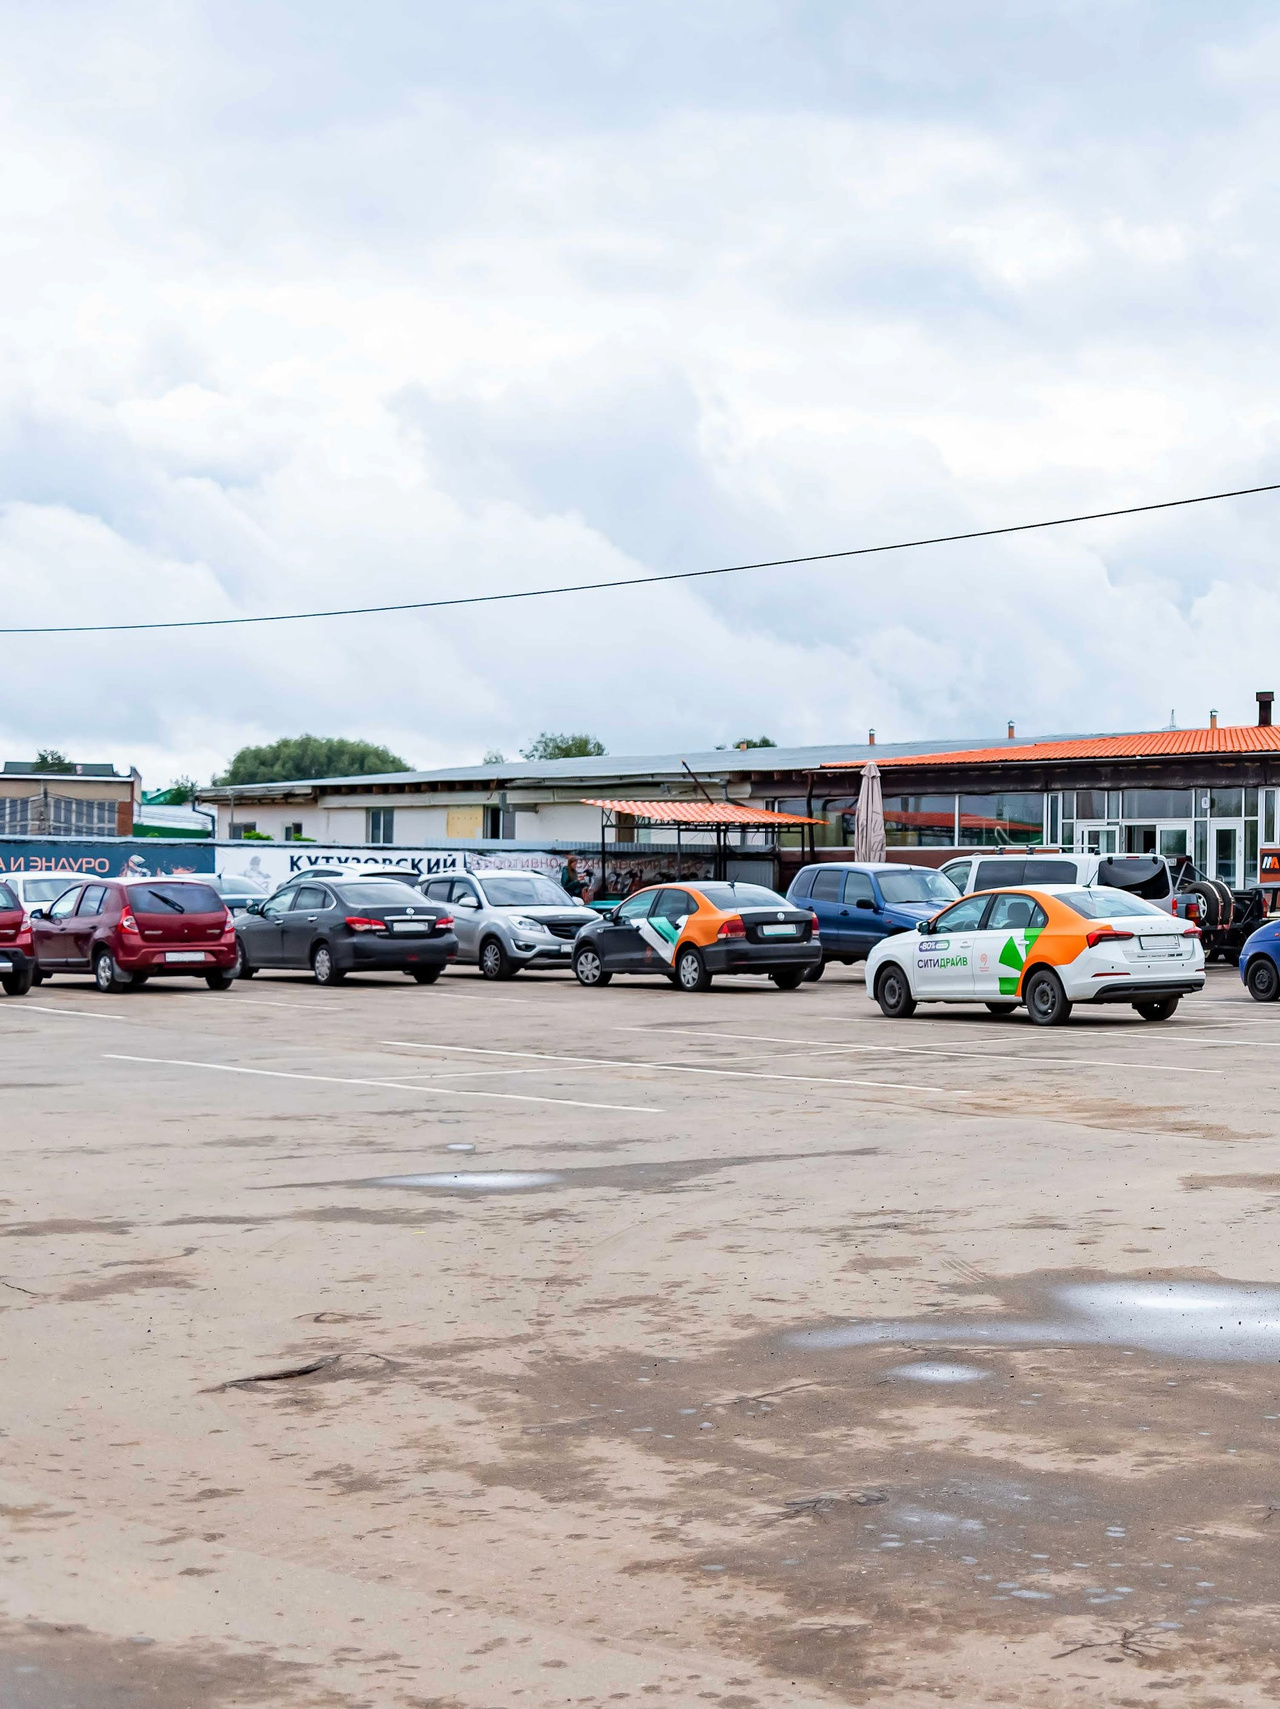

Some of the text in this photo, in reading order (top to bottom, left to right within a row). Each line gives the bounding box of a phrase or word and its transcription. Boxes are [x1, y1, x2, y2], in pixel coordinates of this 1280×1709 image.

[10, 856, 24, 871] И
[29, 856, 110, 873] ЭНДУРО
[917, 955, 968, 969] СИТИДРАЙВ
